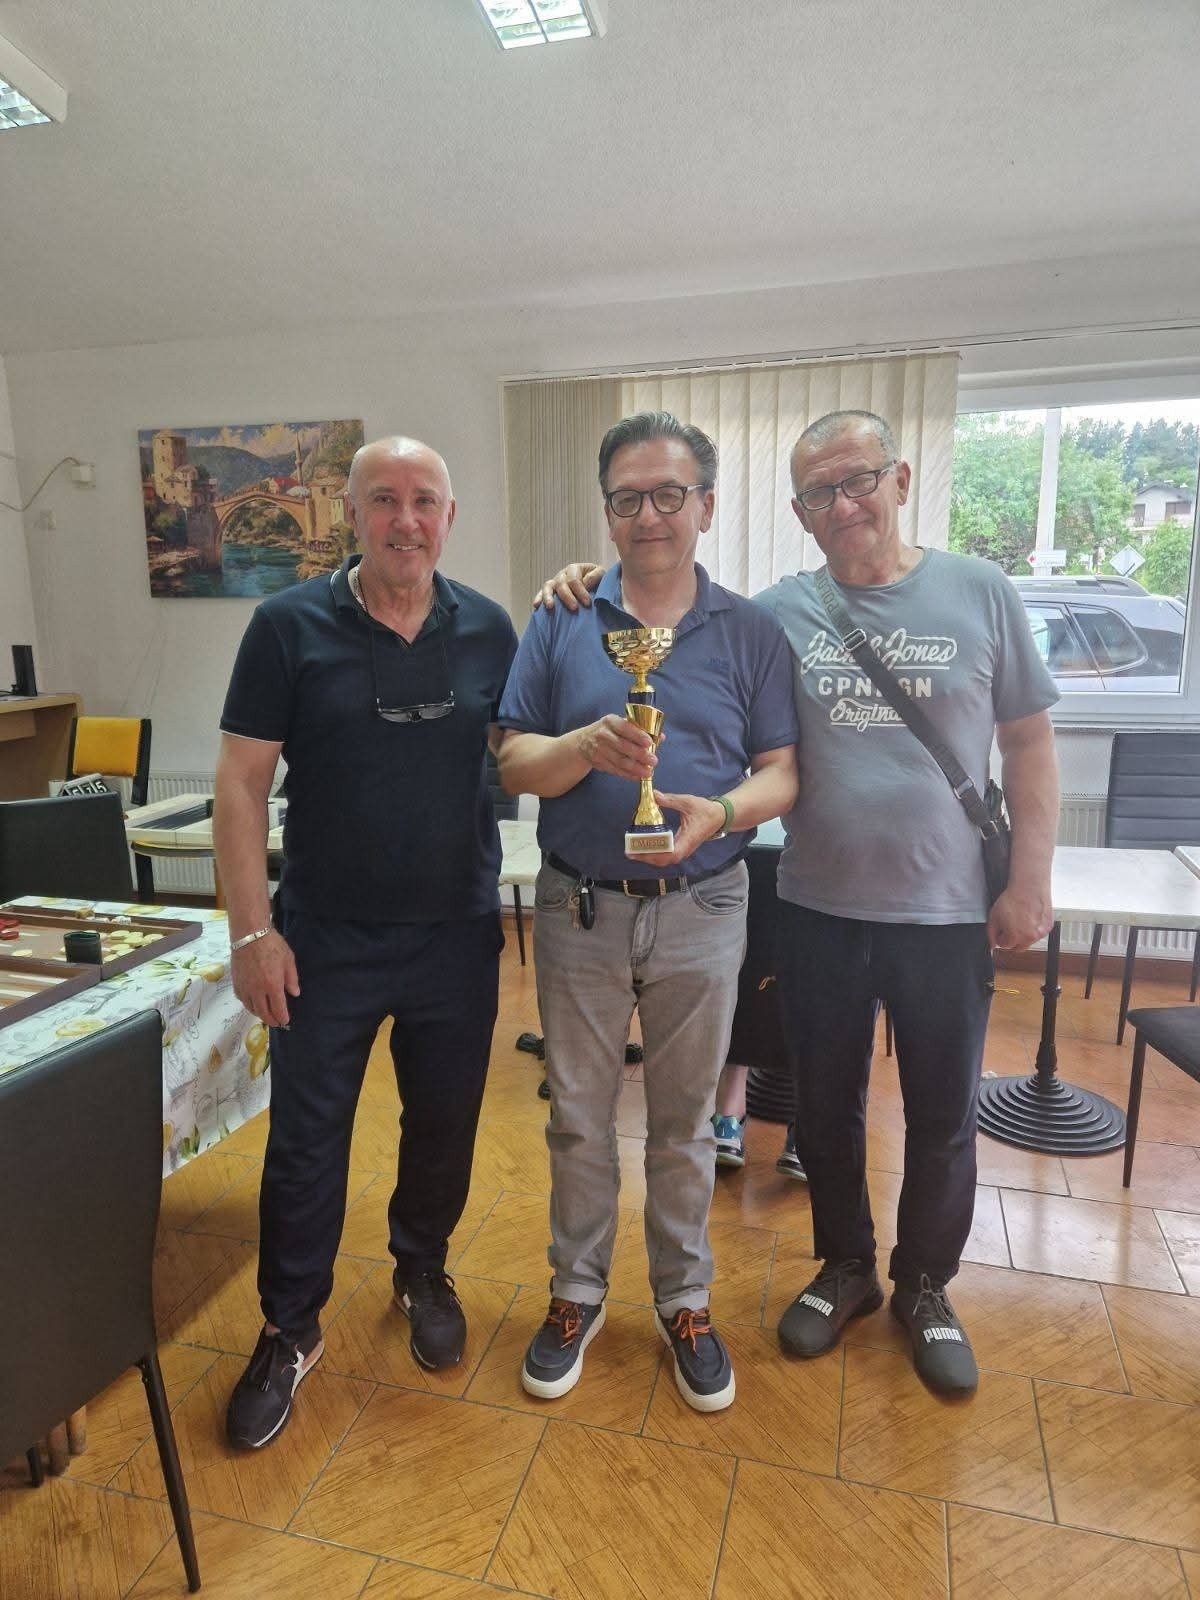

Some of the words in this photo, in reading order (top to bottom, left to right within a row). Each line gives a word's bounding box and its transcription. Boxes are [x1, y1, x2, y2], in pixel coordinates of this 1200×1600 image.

[881, 628, 957, 671] Jones
[818, 676, 931, 697] CPNGN
[799, 1293, 834, 1317] PUMA
[923, 1327, 963, 1343] PUMA
